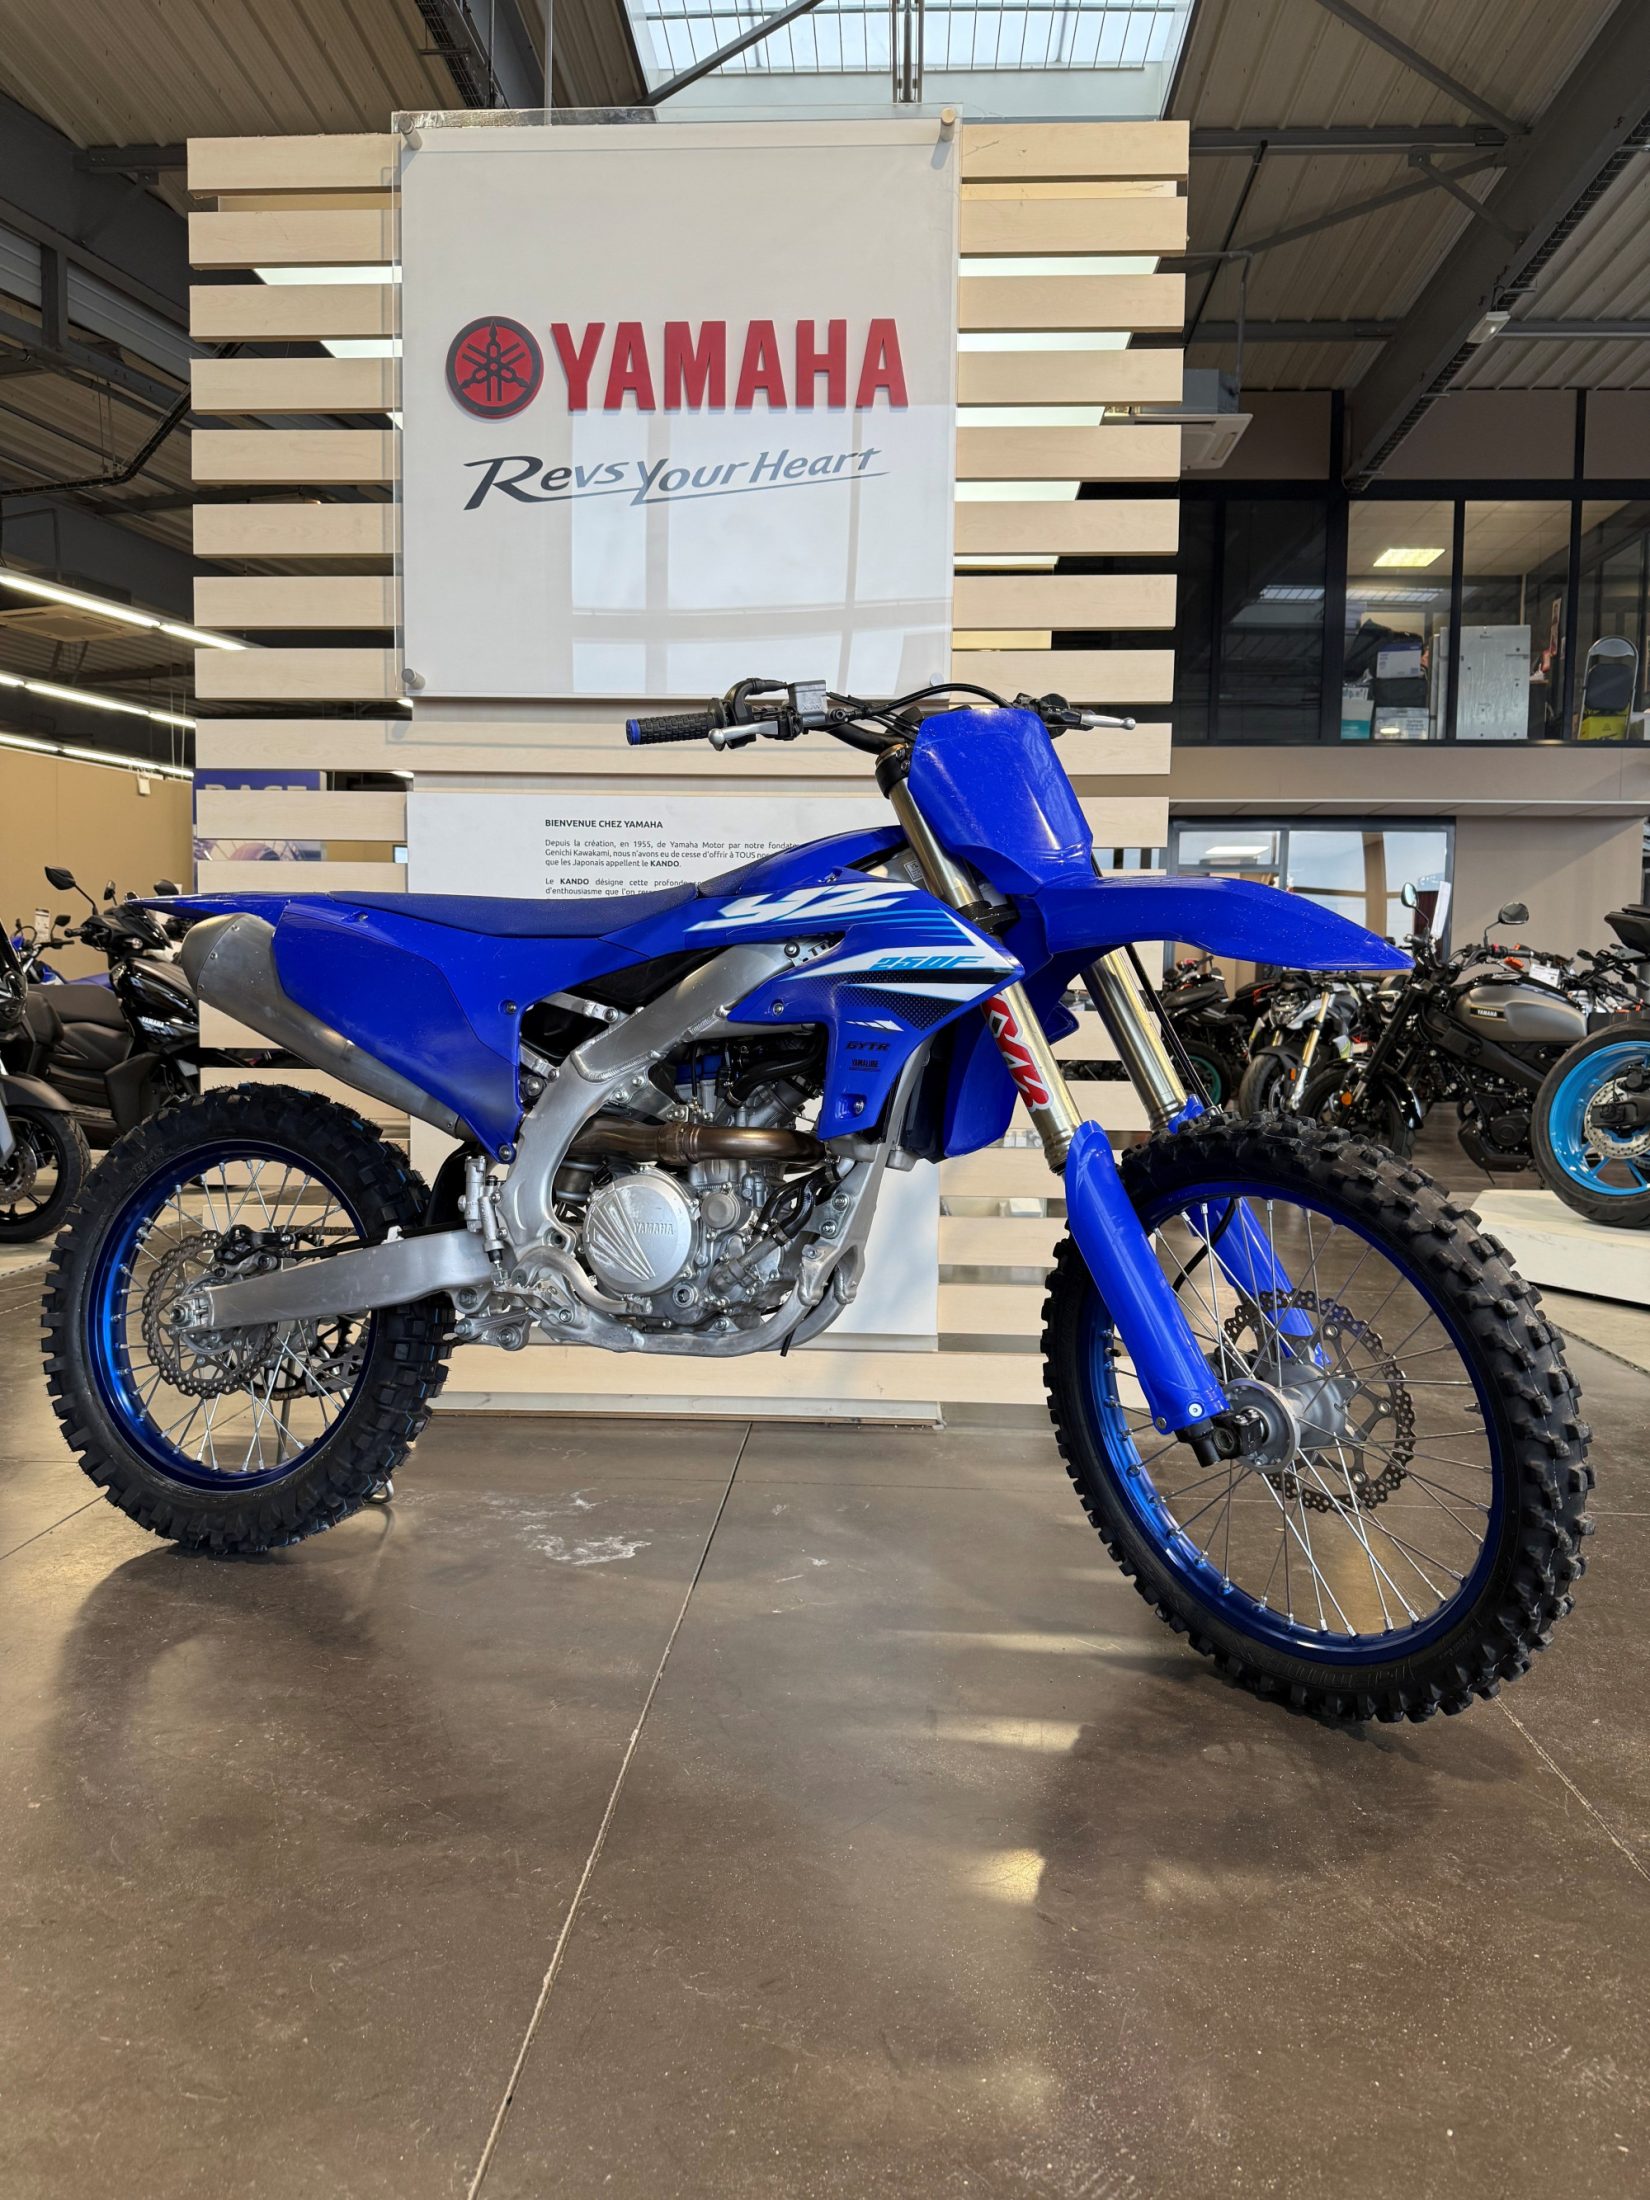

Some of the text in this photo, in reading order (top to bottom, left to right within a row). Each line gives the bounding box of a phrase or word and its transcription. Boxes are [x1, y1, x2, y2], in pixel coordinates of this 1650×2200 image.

[550, 318, 909, 411] YAMAHA
[463, 448, 884, 511] Revs Your Heart
[545, 820, 596, 828] BIENVENUE
[599, 820, 622, 828] CHEZ
[585, 840, 616, 848] création,
[573, 859, 604, 867] Japonais
[606, 859, 640, 867] appellent
[596, 879, 624, 887] désigne
[869, 956, 985, 970] 250F
[1477, 1009, 1498, 1017] YAMAHA
[846, 1041, 891, 1050] GYTR
[634, 1222, 674, 1235] YAMAHA
